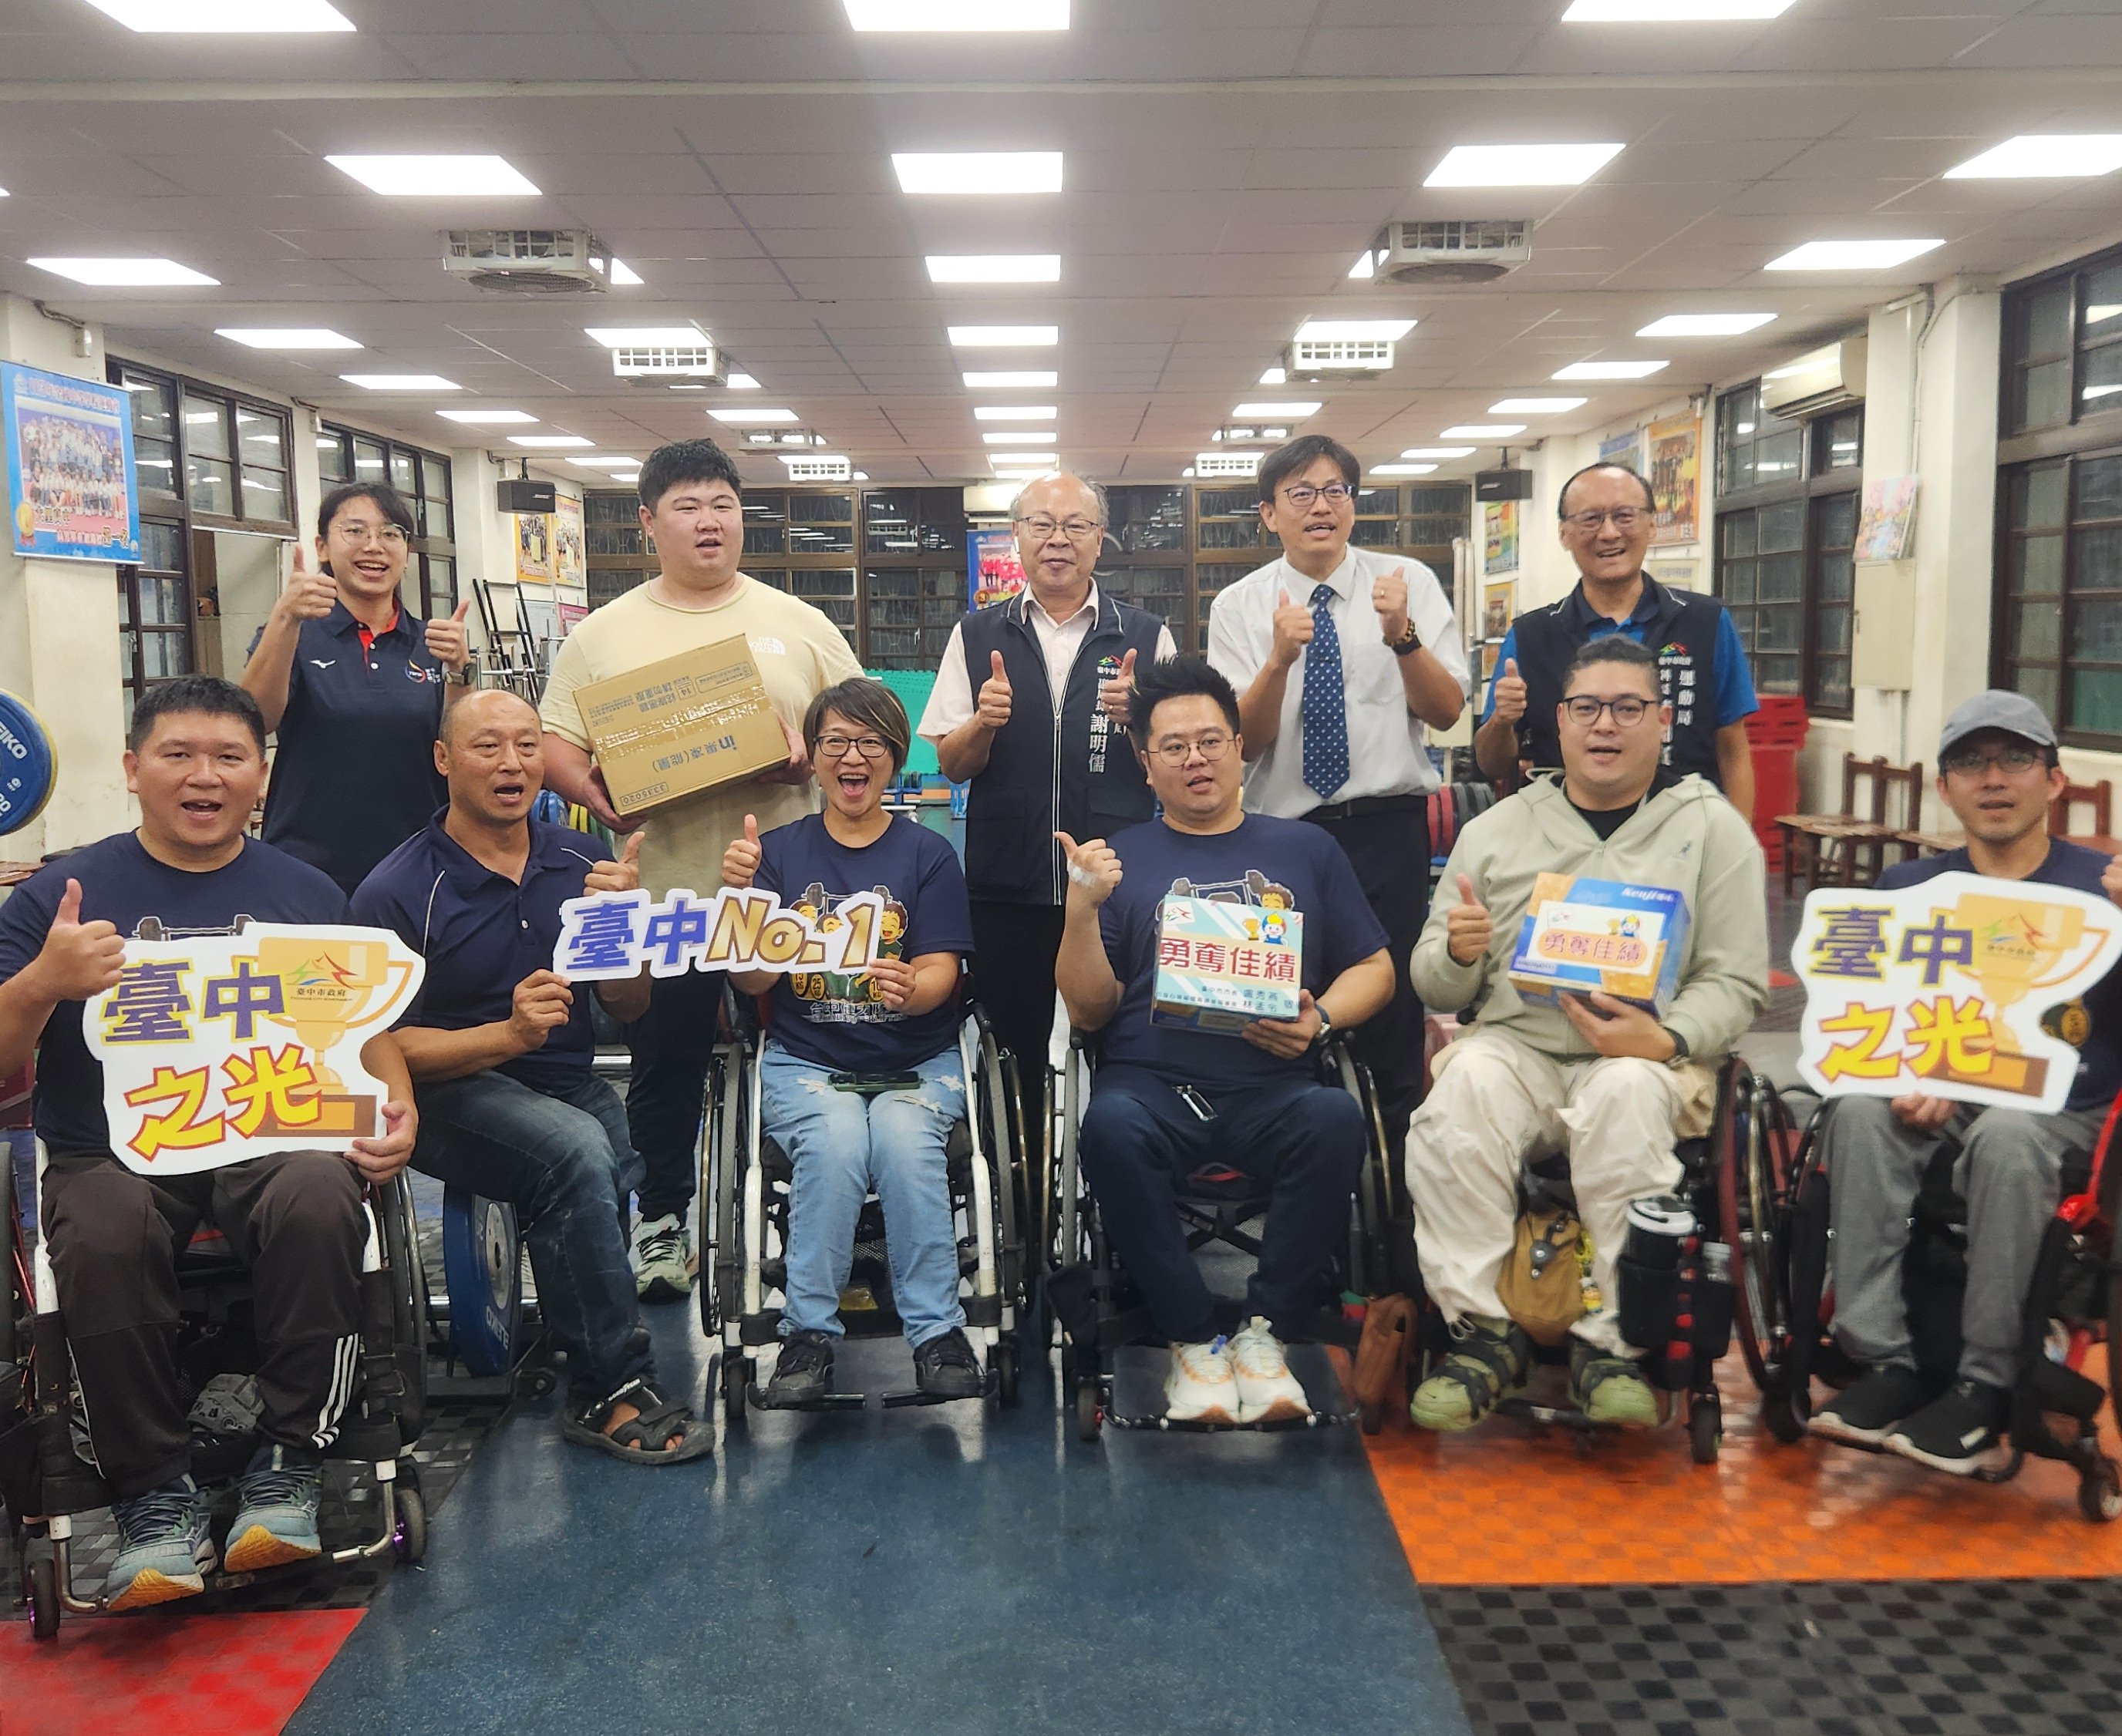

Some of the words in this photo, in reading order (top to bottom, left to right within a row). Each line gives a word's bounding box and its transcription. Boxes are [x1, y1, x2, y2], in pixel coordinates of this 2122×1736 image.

[1676, 669, 1696, 726] 運動局
[1089, 714, 1109, 773] 謝明儒
[566, 900, 707, 971] 臺中
[1160, 937, 1295, 983] 勇奪佳績
[1545, 934, 1641, 963] 勇奪佳績
[1809, 907, 1974, 985] 臺中
[103, 961, 287, 1043] 臺中
[297, 988, 345, 997] 臺中市政府
[812, 978, 821, 990] 25
[1817, 994, 1994, 1085] 之光
[123, 1042, 322, 1162] 之光
